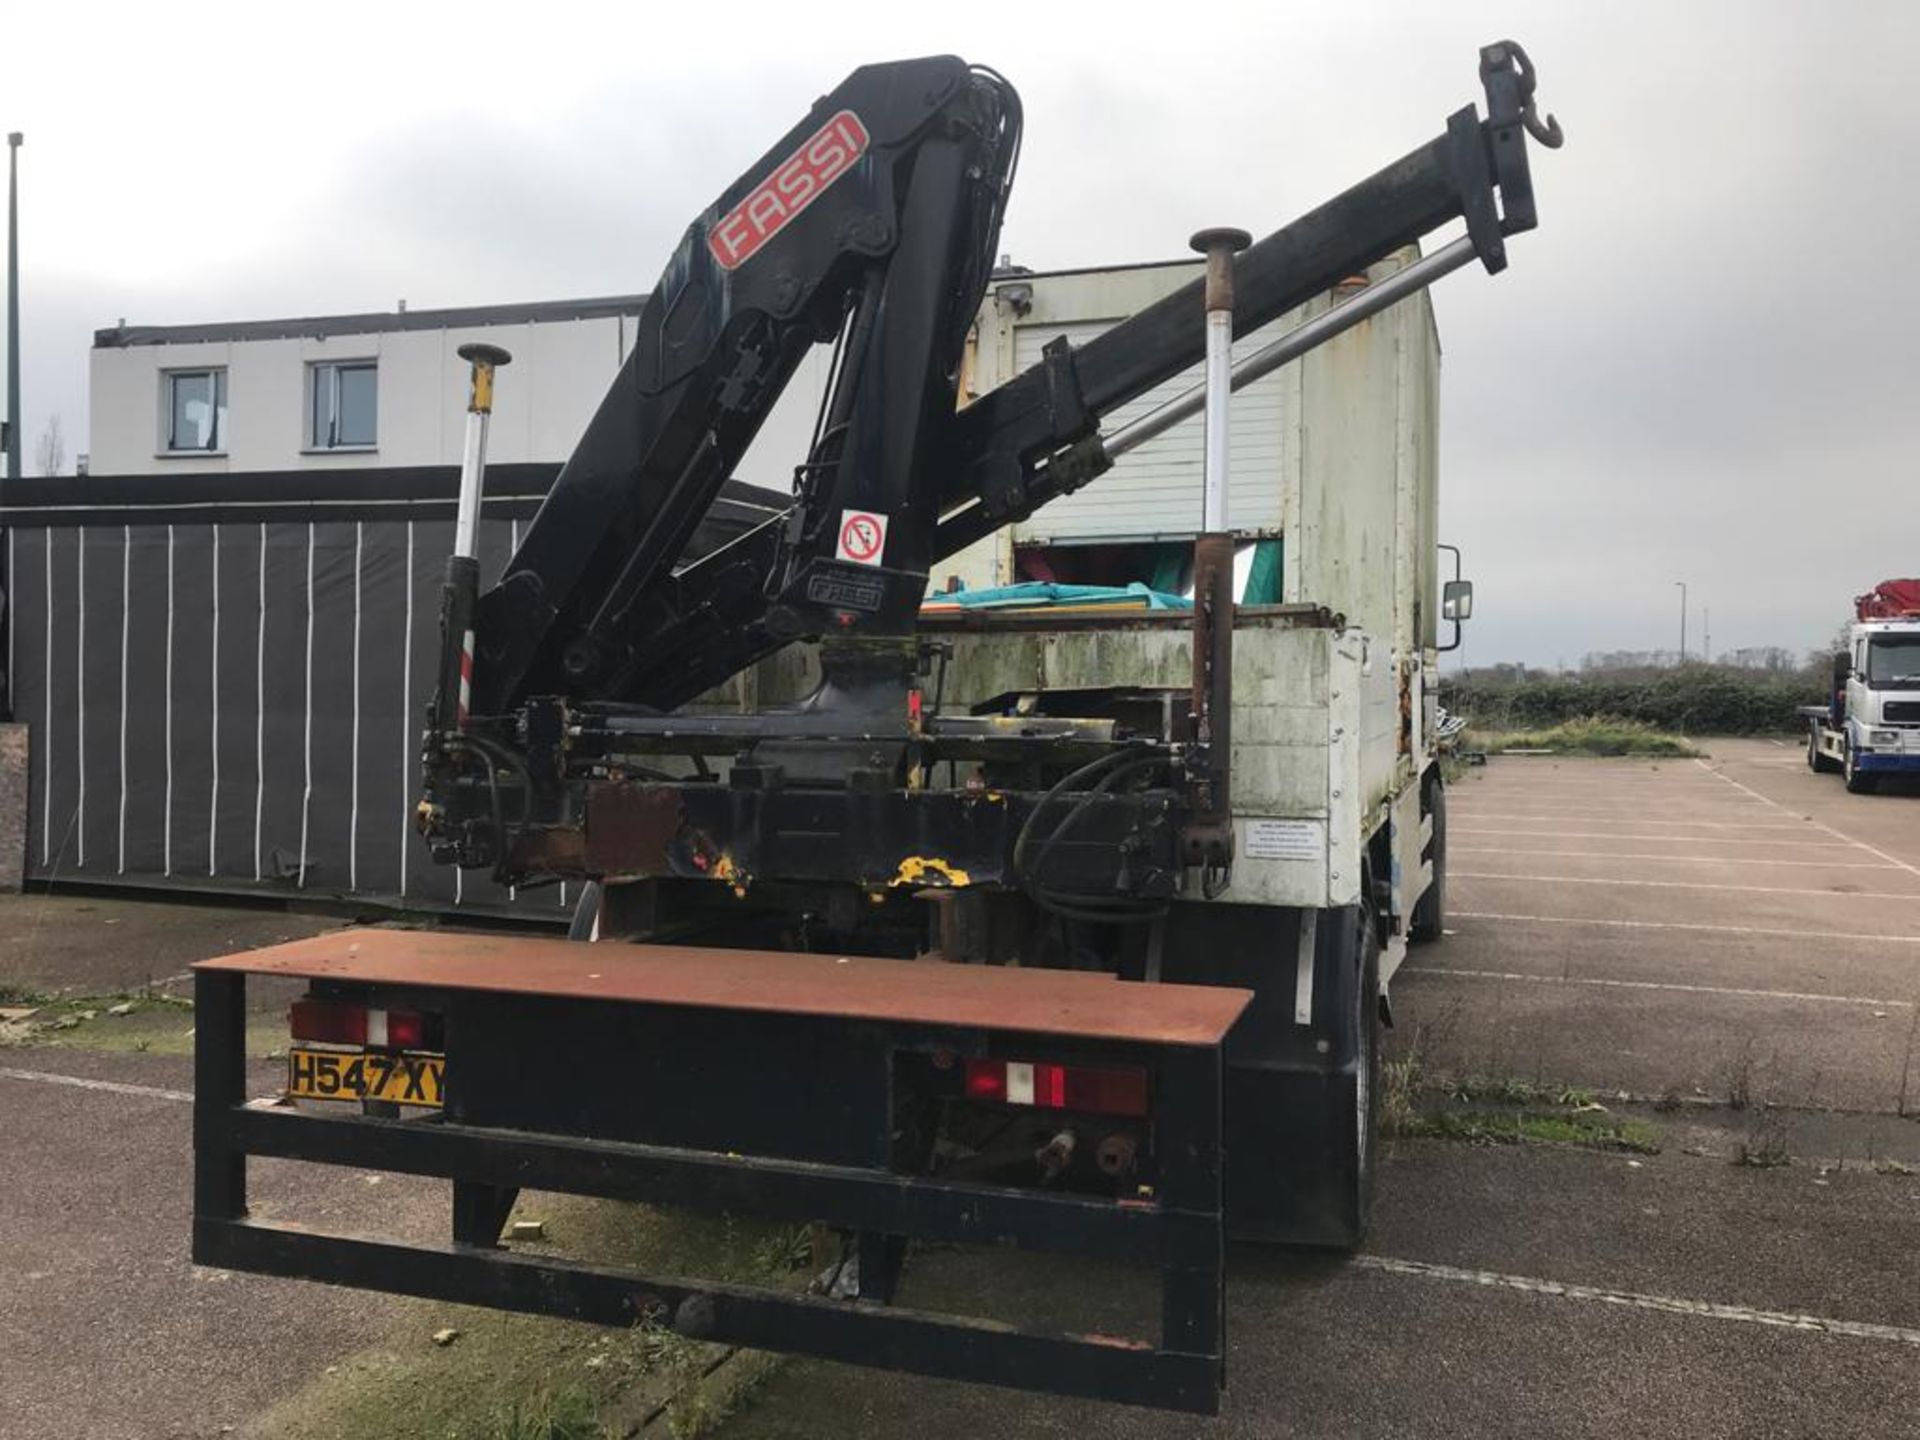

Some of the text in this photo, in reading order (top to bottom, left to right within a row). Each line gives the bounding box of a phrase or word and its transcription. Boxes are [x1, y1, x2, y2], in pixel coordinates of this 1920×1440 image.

[719, 122, 859, 259] FASSI
[813, 581, 878, 608] FASSI
[292, 1054, 394, 1096] H547
